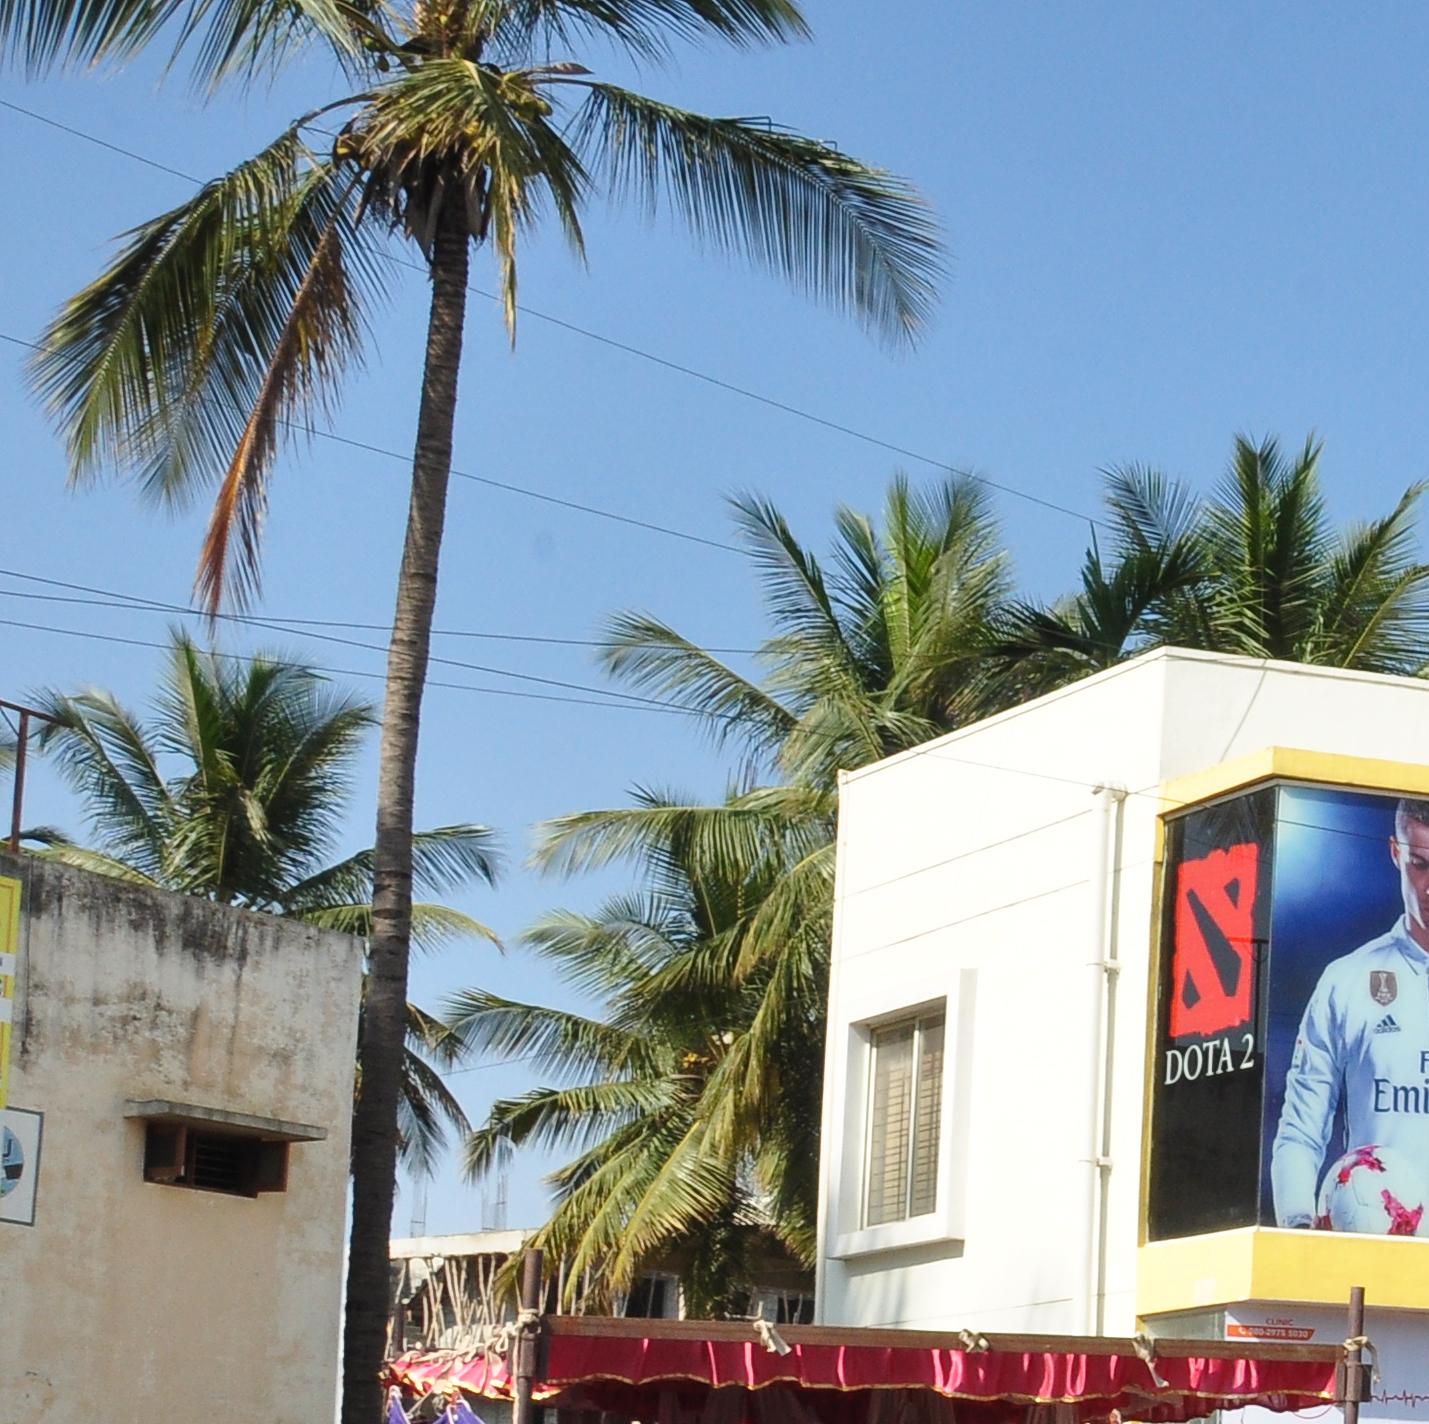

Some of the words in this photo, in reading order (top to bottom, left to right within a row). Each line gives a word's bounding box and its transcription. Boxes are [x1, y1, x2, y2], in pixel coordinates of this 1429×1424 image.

[1164, 1037, 1234, 1086] DOTA
[1240, 1034, 1254, 1069] 2
[1266, 1318, 1294, 1326] CLINIC
